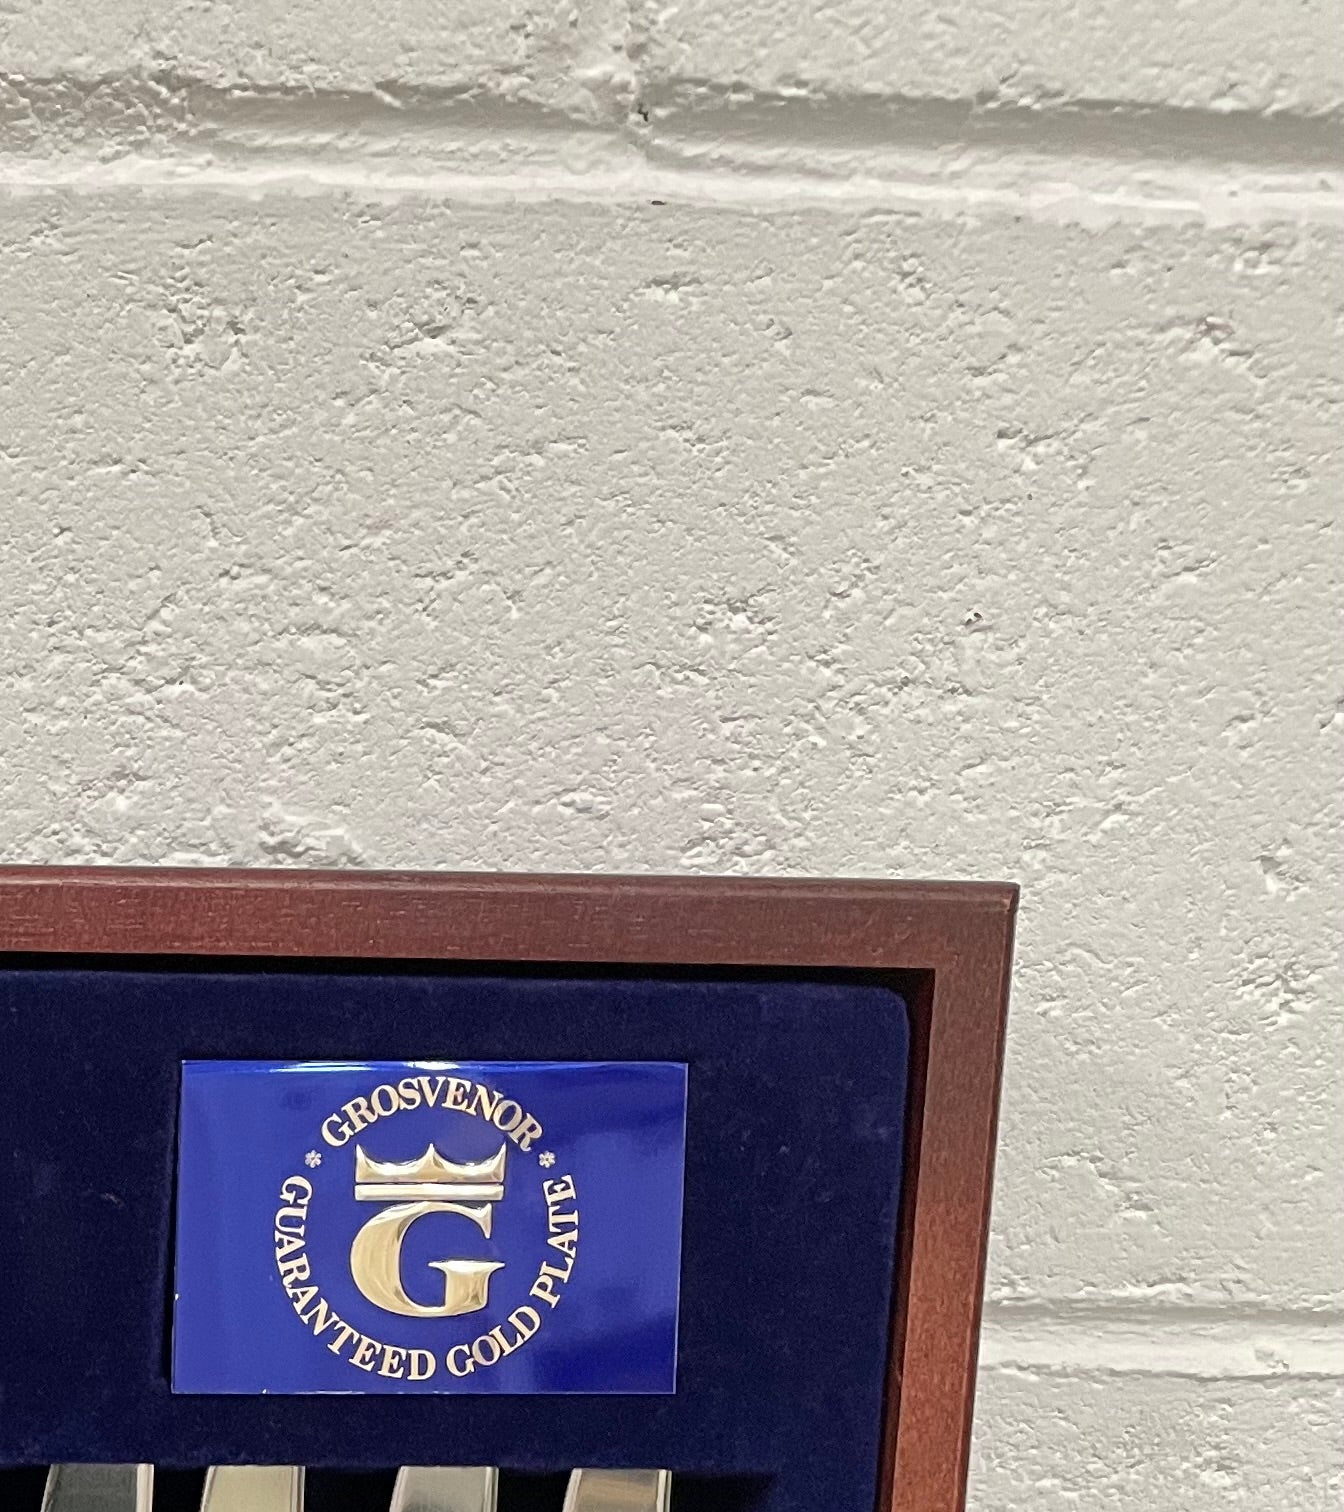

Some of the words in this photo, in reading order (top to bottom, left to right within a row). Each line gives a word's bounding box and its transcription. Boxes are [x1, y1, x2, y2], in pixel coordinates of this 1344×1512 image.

[320, 1075, 543, 1152] GROSVENOR
[273, 1174, 437, 1381] GUARANTEED
[446, 1305, 542, 1378] GOLD
[529, 1174, 579, 1309] PLATE
